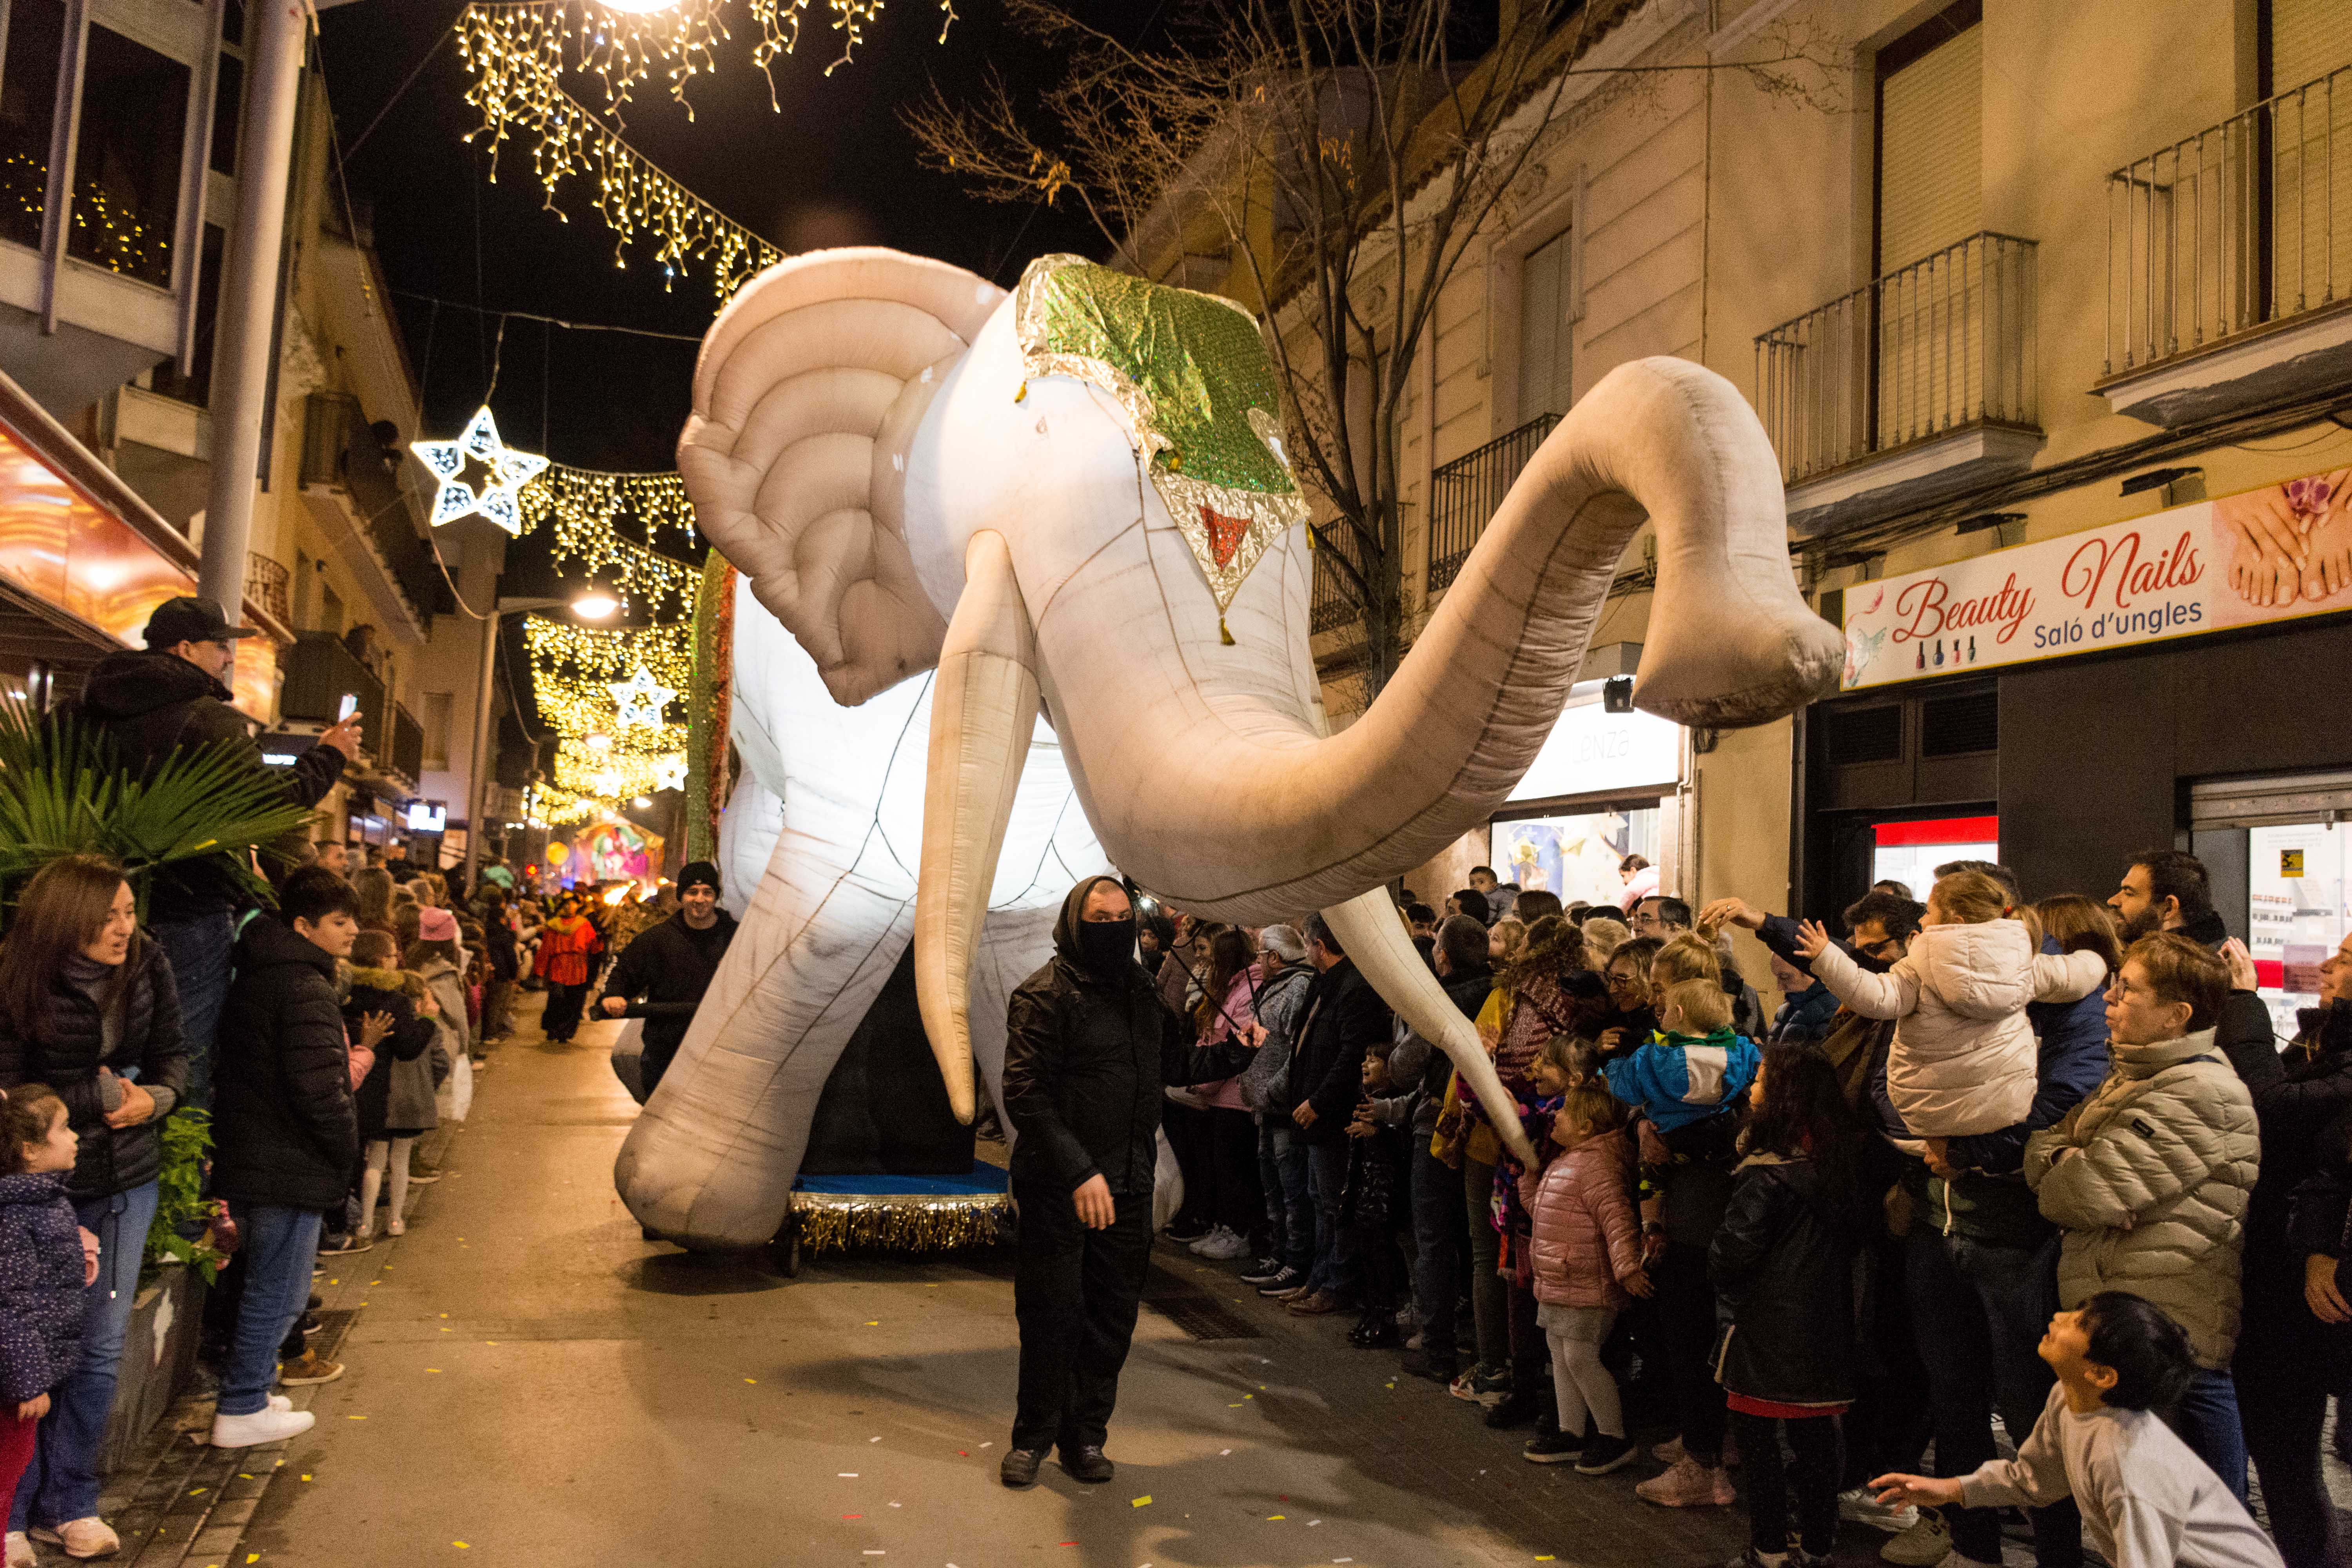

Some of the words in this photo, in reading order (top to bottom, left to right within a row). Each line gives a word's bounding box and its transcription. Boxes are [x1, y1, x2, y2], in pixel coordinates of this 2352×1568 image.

[1892, 572, 2035, 644] Beauty
[2061, 531, 2204, 609] Nails
[2034, 617, 2083, 649] Saló
